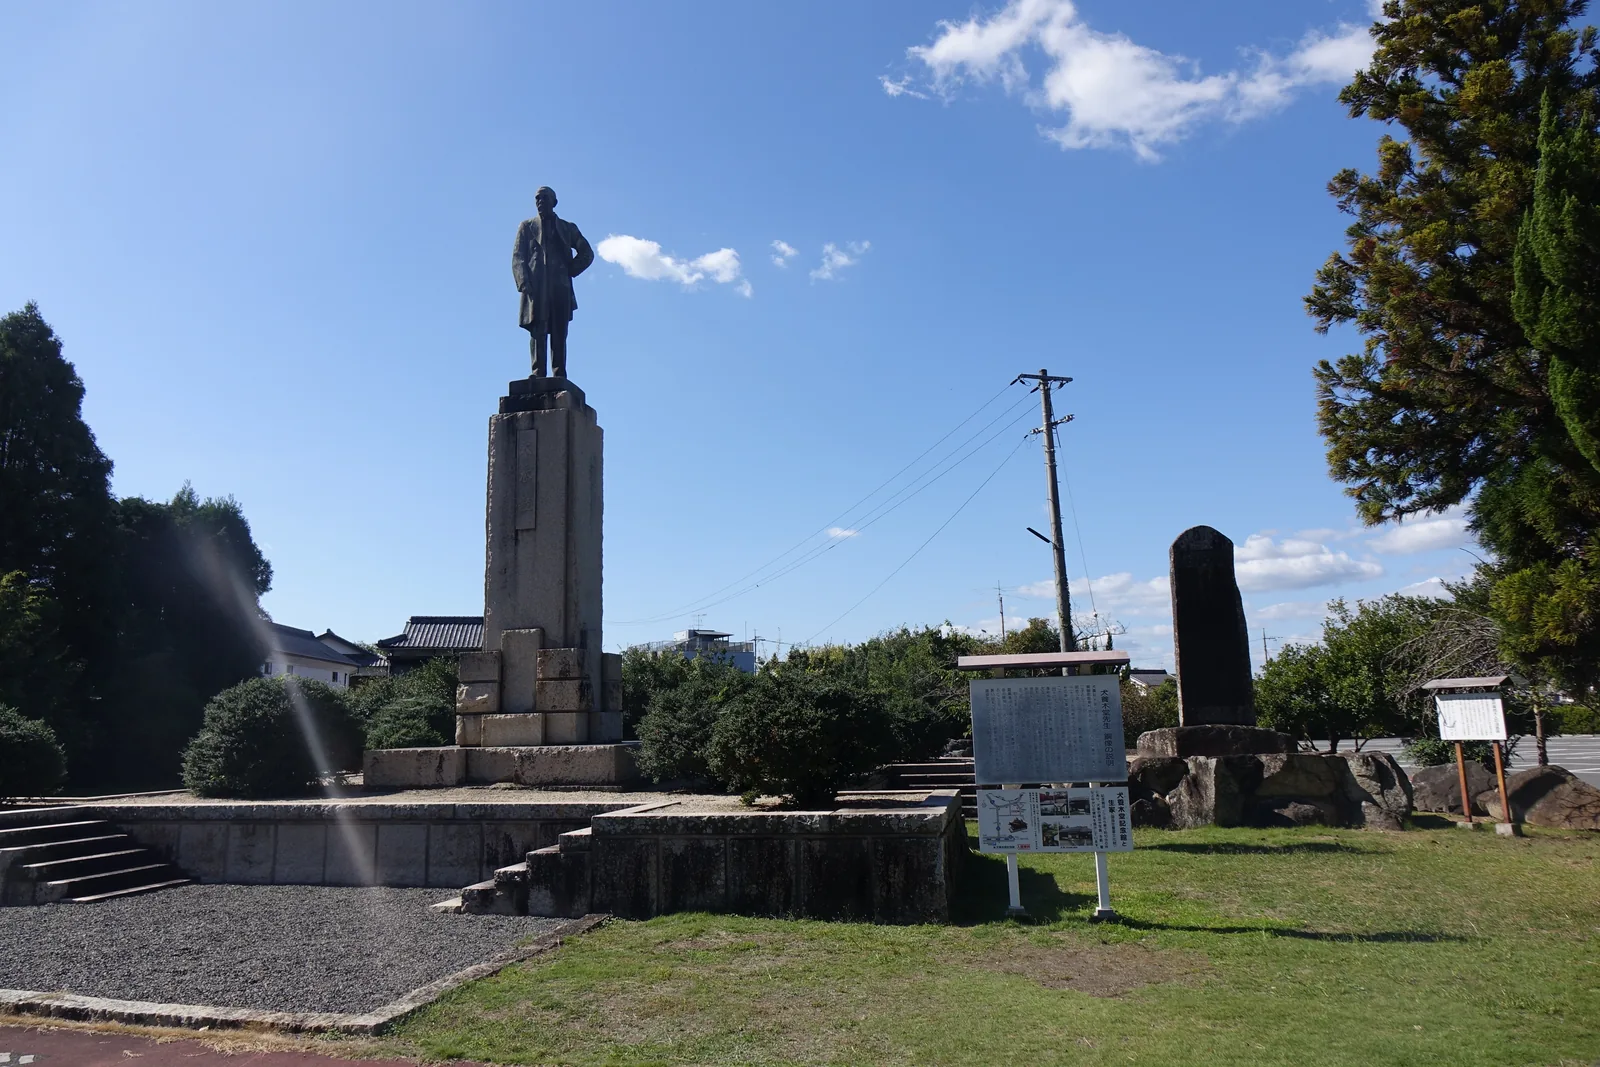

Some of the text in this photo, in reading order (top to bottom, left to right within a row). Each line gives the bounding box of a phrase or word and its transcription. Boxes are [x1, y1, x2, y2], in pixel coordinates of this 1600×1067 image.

[1100, 689, 1111, 730] 犬養木堂先生
[1108, 799, 1116, 813] 生家
[1116, 792, 1128, 847] 犬養木堂記念館と
